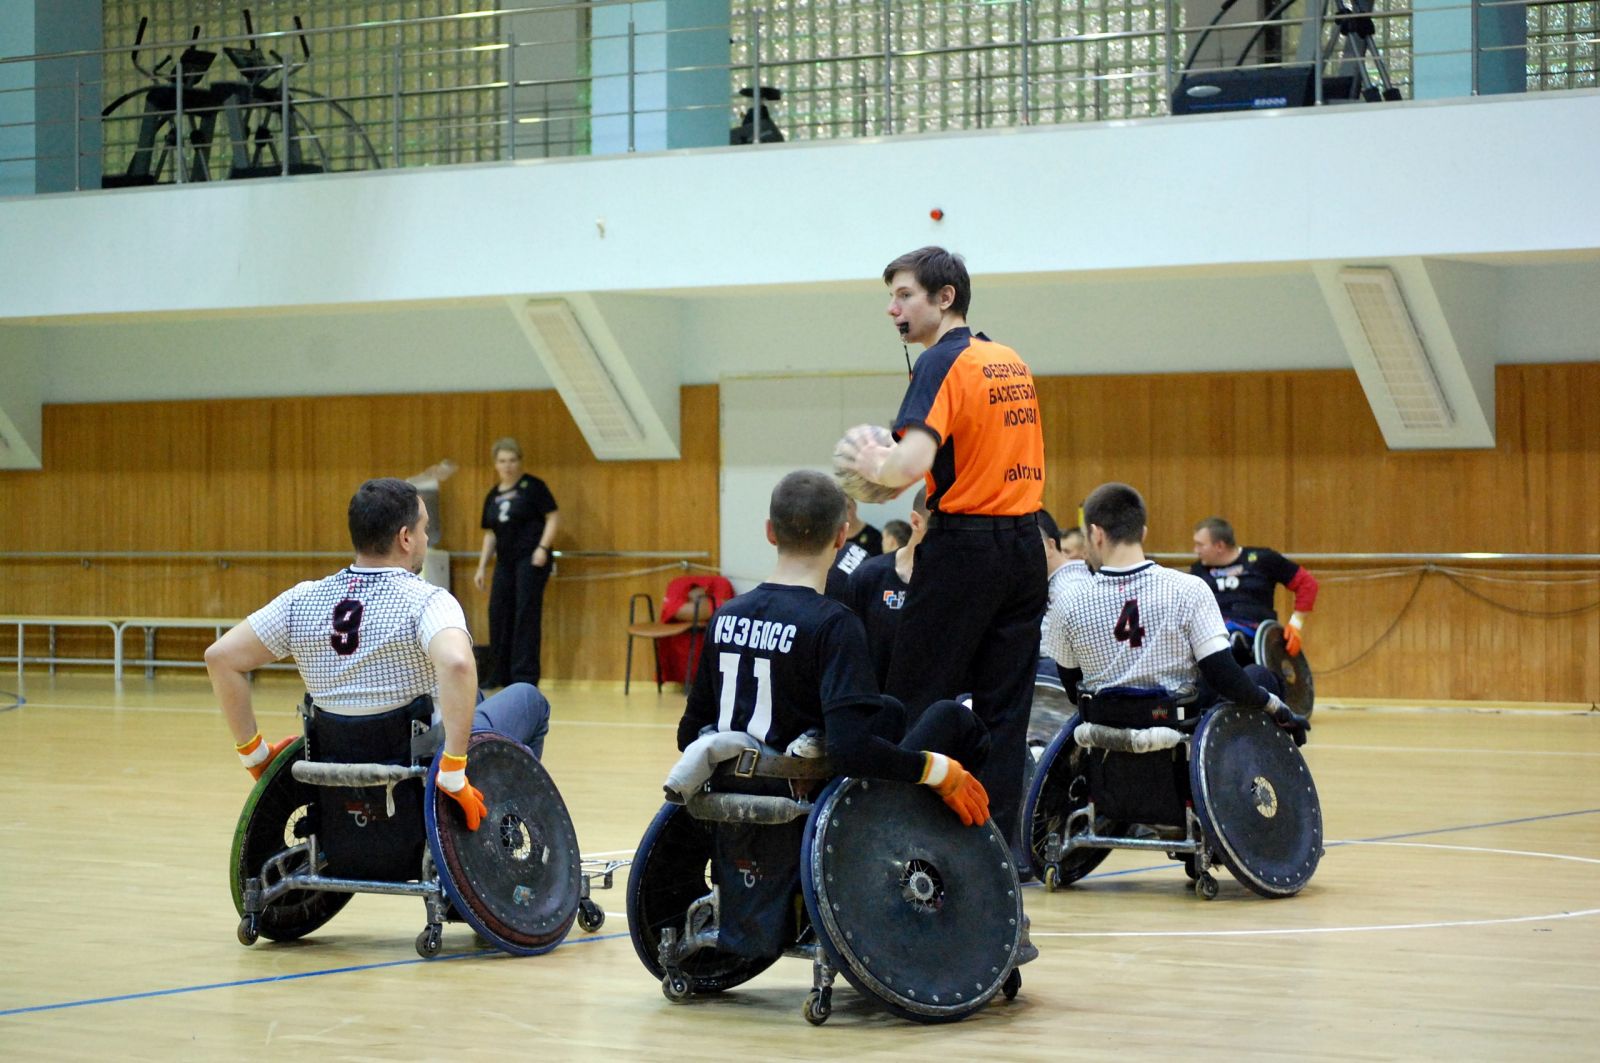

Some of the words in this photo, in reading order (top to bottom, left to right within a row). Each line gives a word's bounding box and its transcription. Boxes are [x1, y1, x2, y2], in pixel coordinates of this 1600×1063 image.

[499, 500, 511, 522] 2
[331, 598, 363, 655] 9
[714, 615, 797, 654] КУЗБАСС
[1113, 599, 1145, 648] 4
[717, 651, 772, 742] 11
